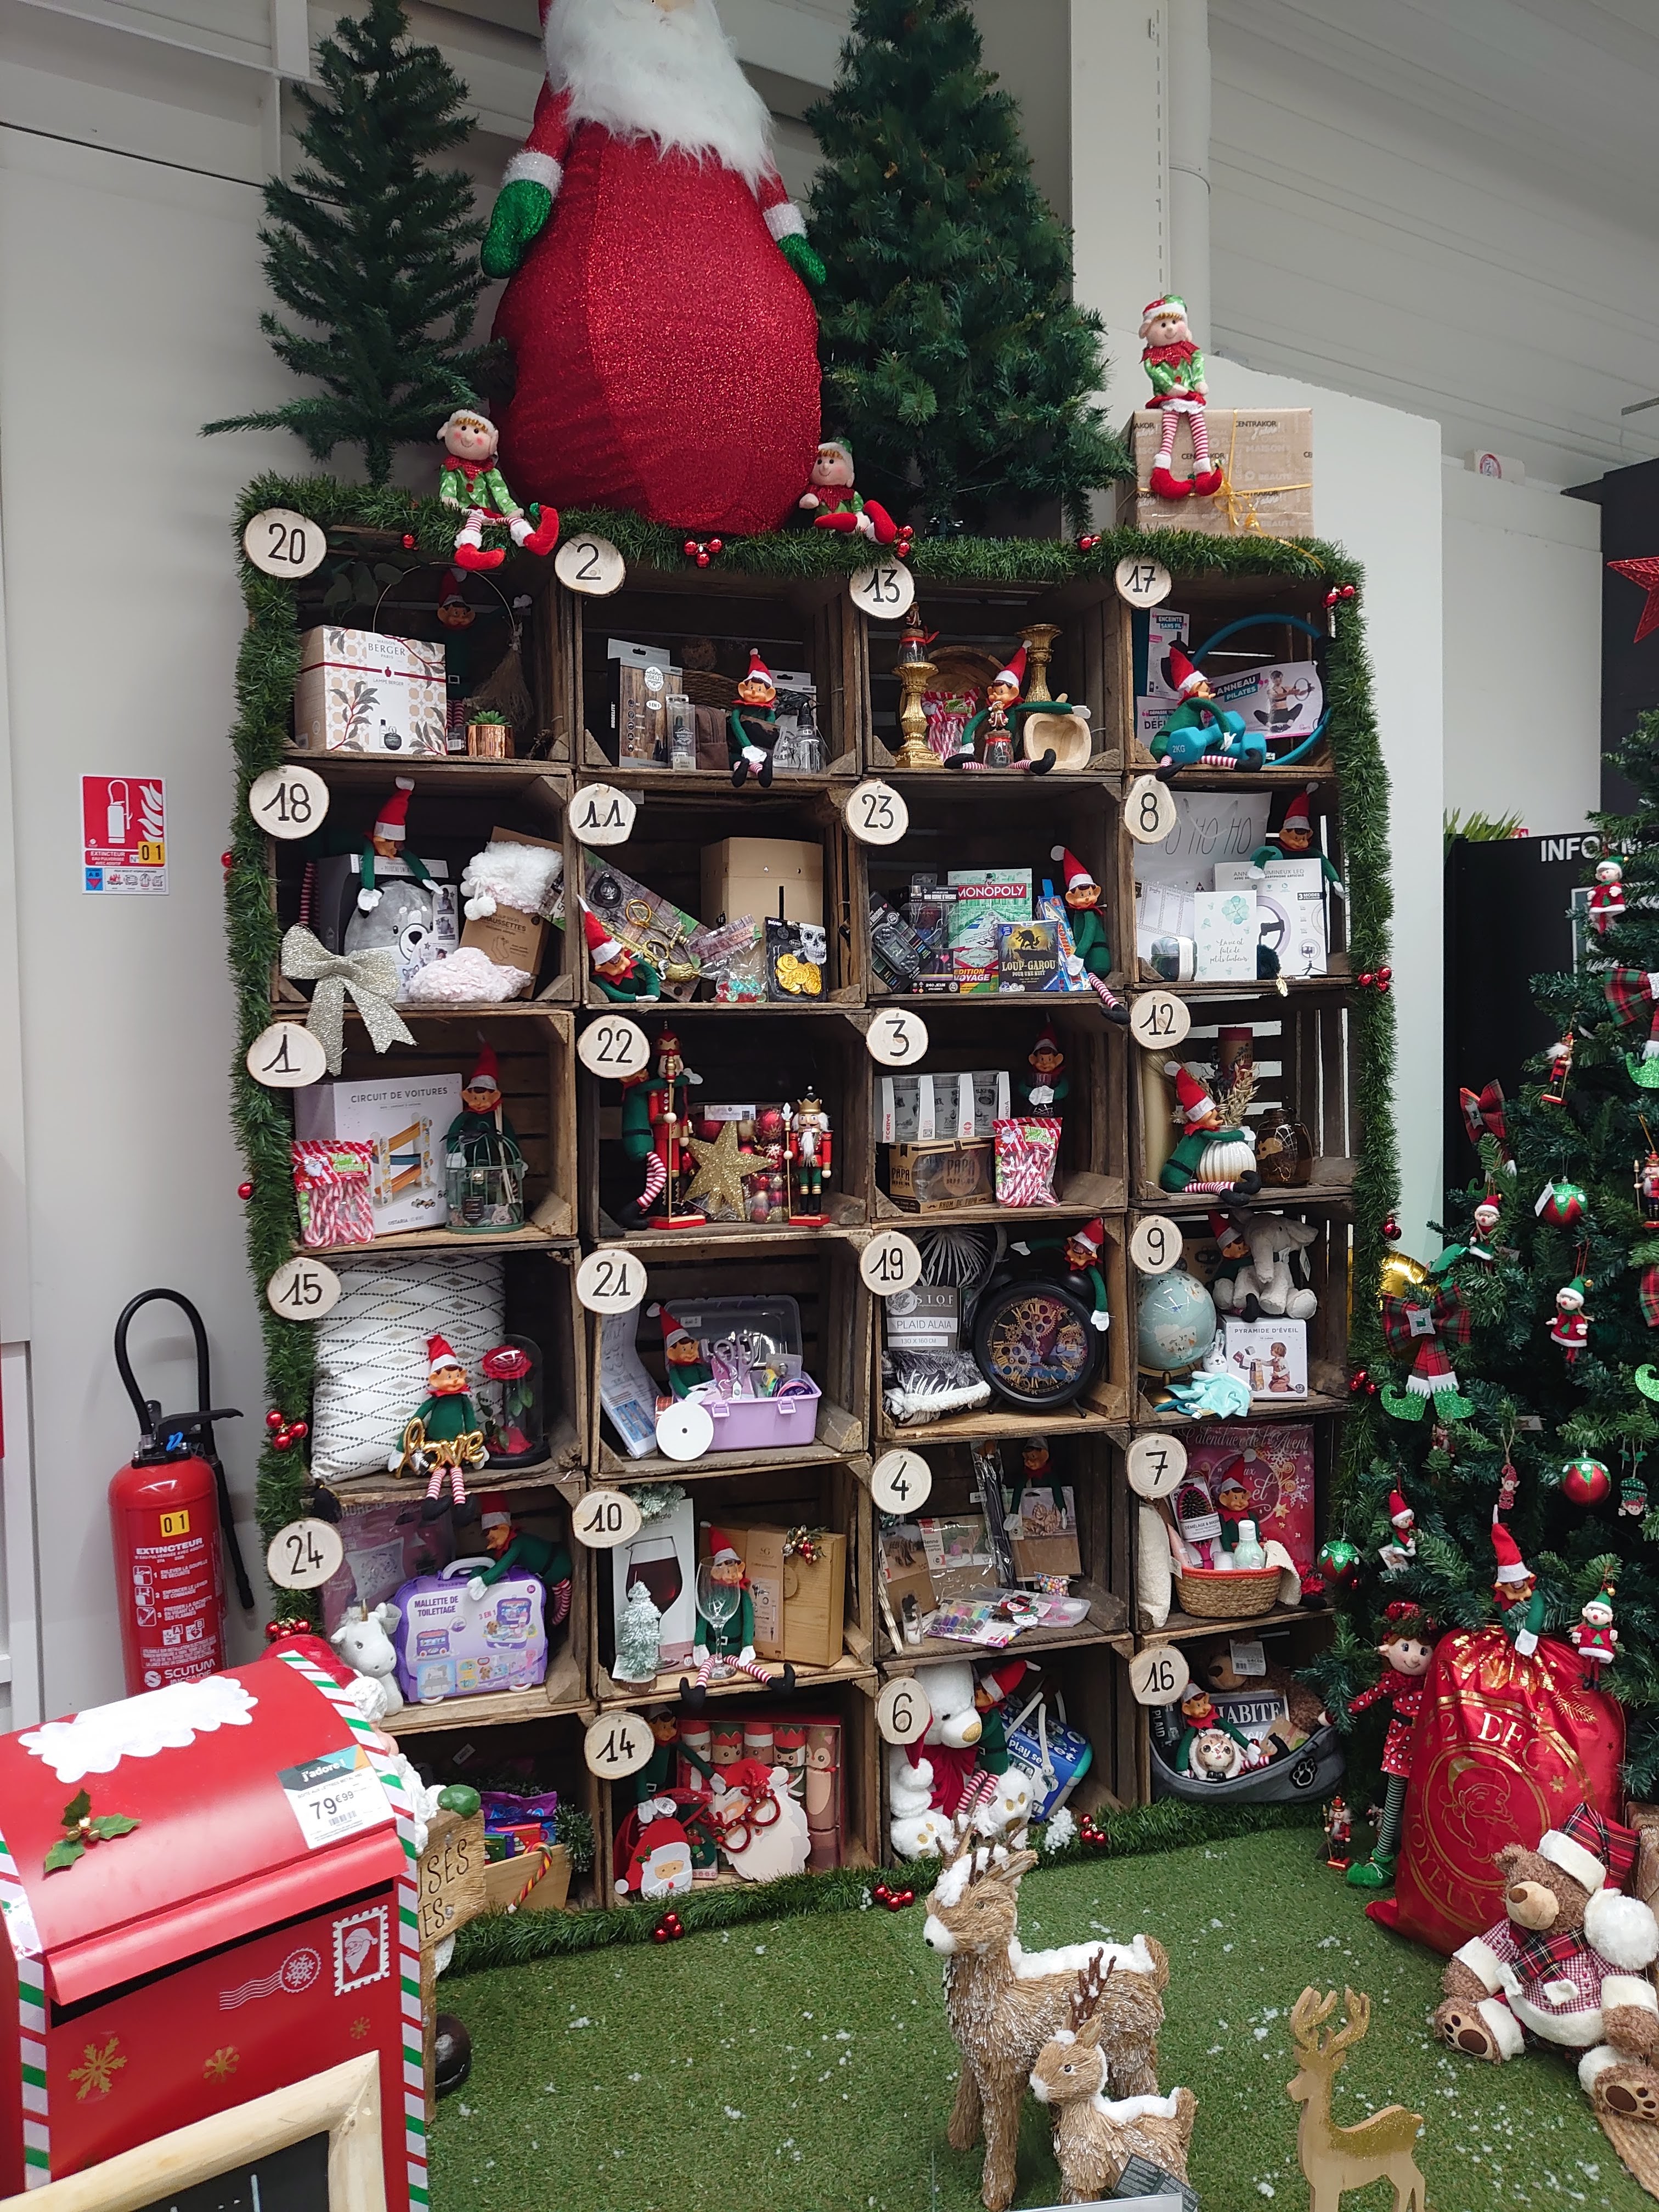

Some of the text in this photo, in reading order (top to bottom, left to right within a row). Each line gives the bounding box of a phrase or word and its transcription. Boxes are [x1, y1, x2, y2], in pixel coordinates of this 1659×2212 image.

[268, 522, 306, 565] 20
[575, 543, 602, 580] 2
[862, 569, 901, 603] 13
[1124, 565, 1156, 593] 17
[368, 642, 406, 656] BERGER
[1216, 676, 1256, 695] ANNEAU
[1226, 686, 1257, 701] PILATES
[1172, 744, 1186, 753] 2KG
[262, 782, 312, 823] 18
[861, 793, 894, 830] 23
[1139, 792, 1159, 832] 8
[958, 885, 1024, 898] MONOPOLY
[1001, 960, 1056, 972] LOUP-GAROU
[1139, 1003, 1177, 1035] 12
[596, 1027, 633, 1064] 22
[885, 1019, 910, 1057] 3
[262, 1034, 301, 1074] 1
[351, 1087, 448, 1103] CIRCUIT DE VOITURES
[891, 1167, 910, 1180] PAPA
[947, 1159, 975, 1176] PAPA
[1147, 1227, 1165, 1266] 9
[869, 1248, 904, 1281] 19
[279, 1273, 323, 1306] 15
[592, 1261, 631, 1297] 21
[916, 1295, 954, 1305] STOF
[897, 1320, 952, 1329] PLAID ALAIA
[1178, 1426, 1243, 1446] Calendrier
[890, 1460, 909, 1502] 4
[1146, 1450, 1169, 1486] 7
[163, 1514, 185, 1533] 01
[583, 1503, 622, 1532] 10
[136, 1537, 203, 1555] EXTINCTEUR
[286, 1531, 324, 1575] 24
[414, 1595, 459, 1608] MALLETTE DE
[417, 1605, 456, 1617] TOILETTAGE
[196, 1620, 203, 1628] B
[165, 1658, 216, 1679] SCUTUM
[1142, 1661, 1175, 1692] 16
[891, 1692, 913, 1734] 6
[1152, 1710, 1165, 1738] PLAID
[595, 1729, 635, 1764] 14
[302, 1761, 340, 1782] j'adore
